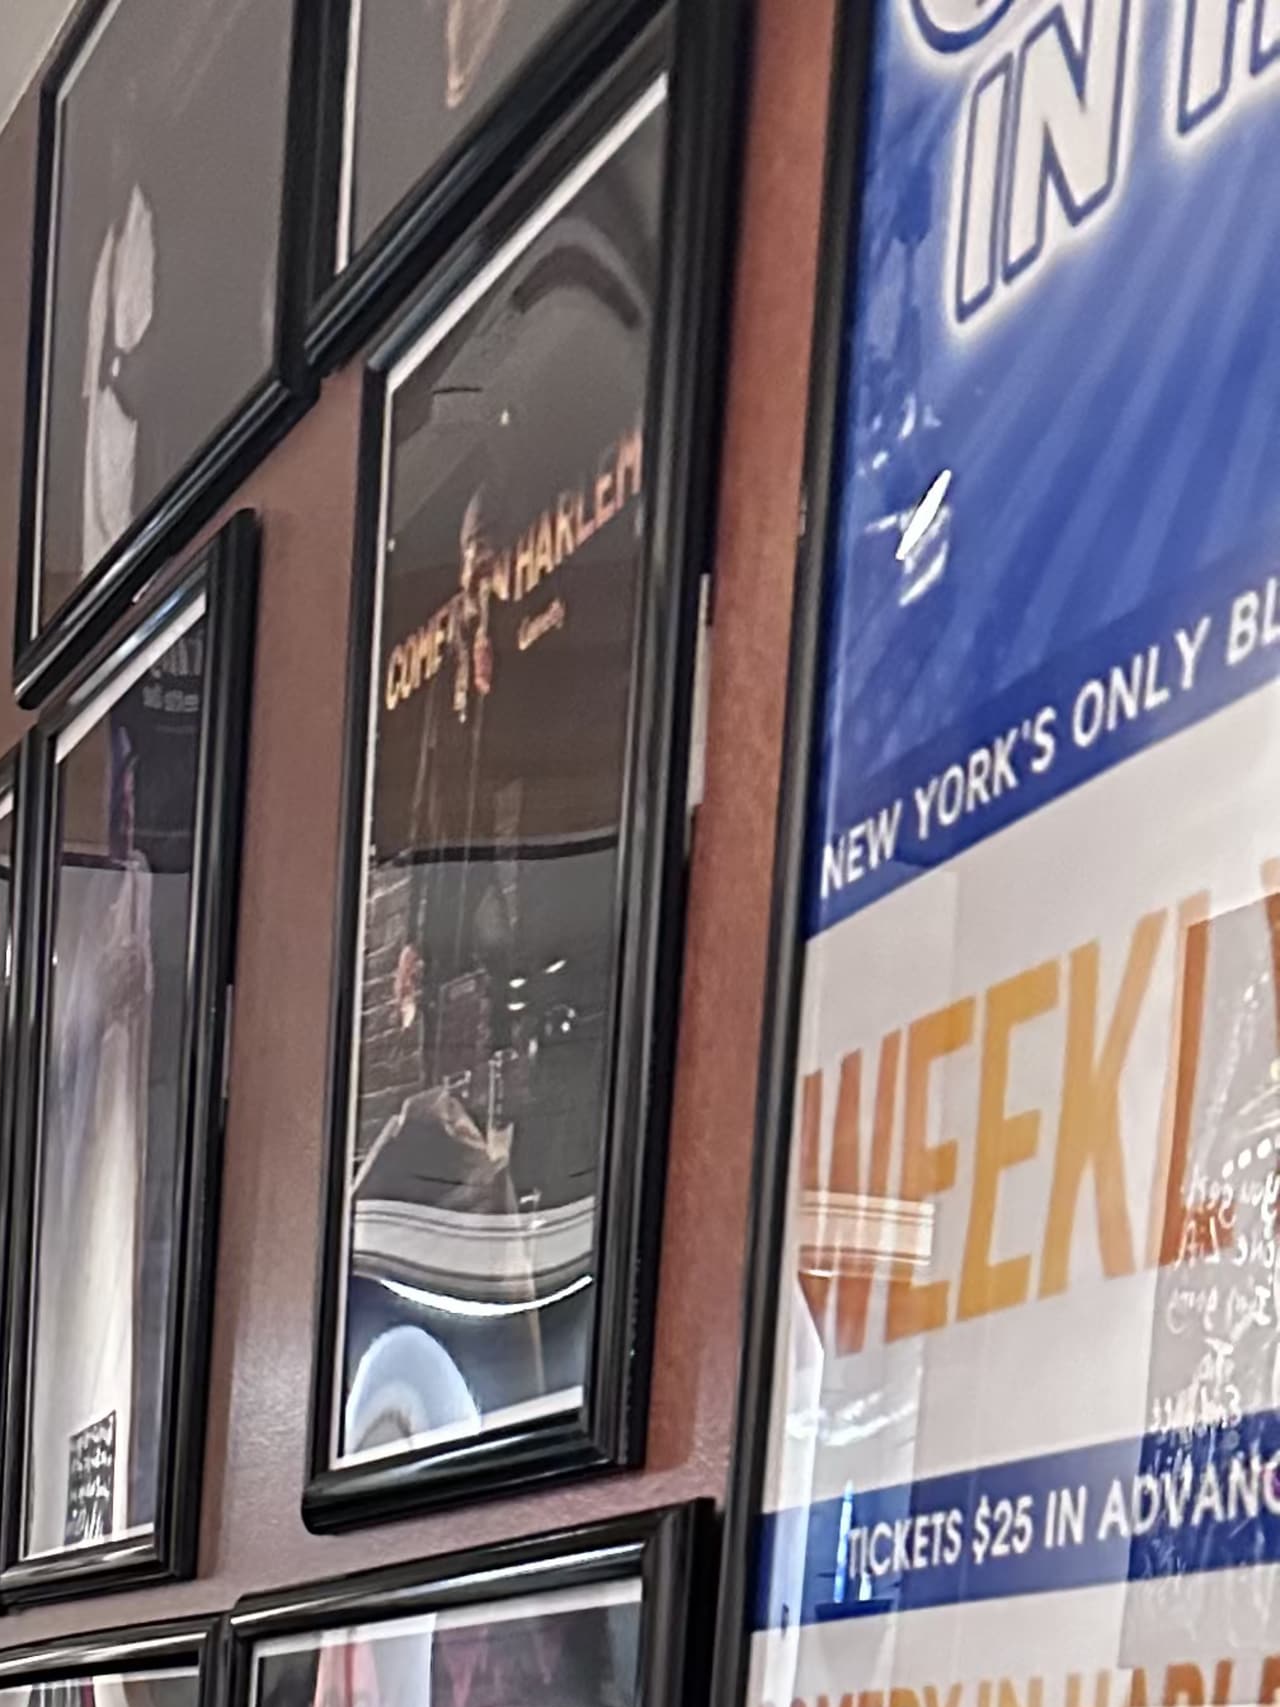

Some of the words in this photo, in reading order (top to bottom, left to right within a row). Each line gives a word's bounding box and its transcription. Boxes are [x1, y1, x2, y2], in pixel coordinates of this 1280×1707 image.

[955, 0, 1132, 324] IN
[513, 428, 643, 602] HARLEM
[820, 799, 903, 899] NEW
[914, 706, 1057, 840] YORK'S
[1073, 616, 1212, 748] ONLY
[849, 1508, 964, 1579] TICKETS
[972, 1494, 1035, 1566] $25
[1044, 1485, 1086, 1549] IN
